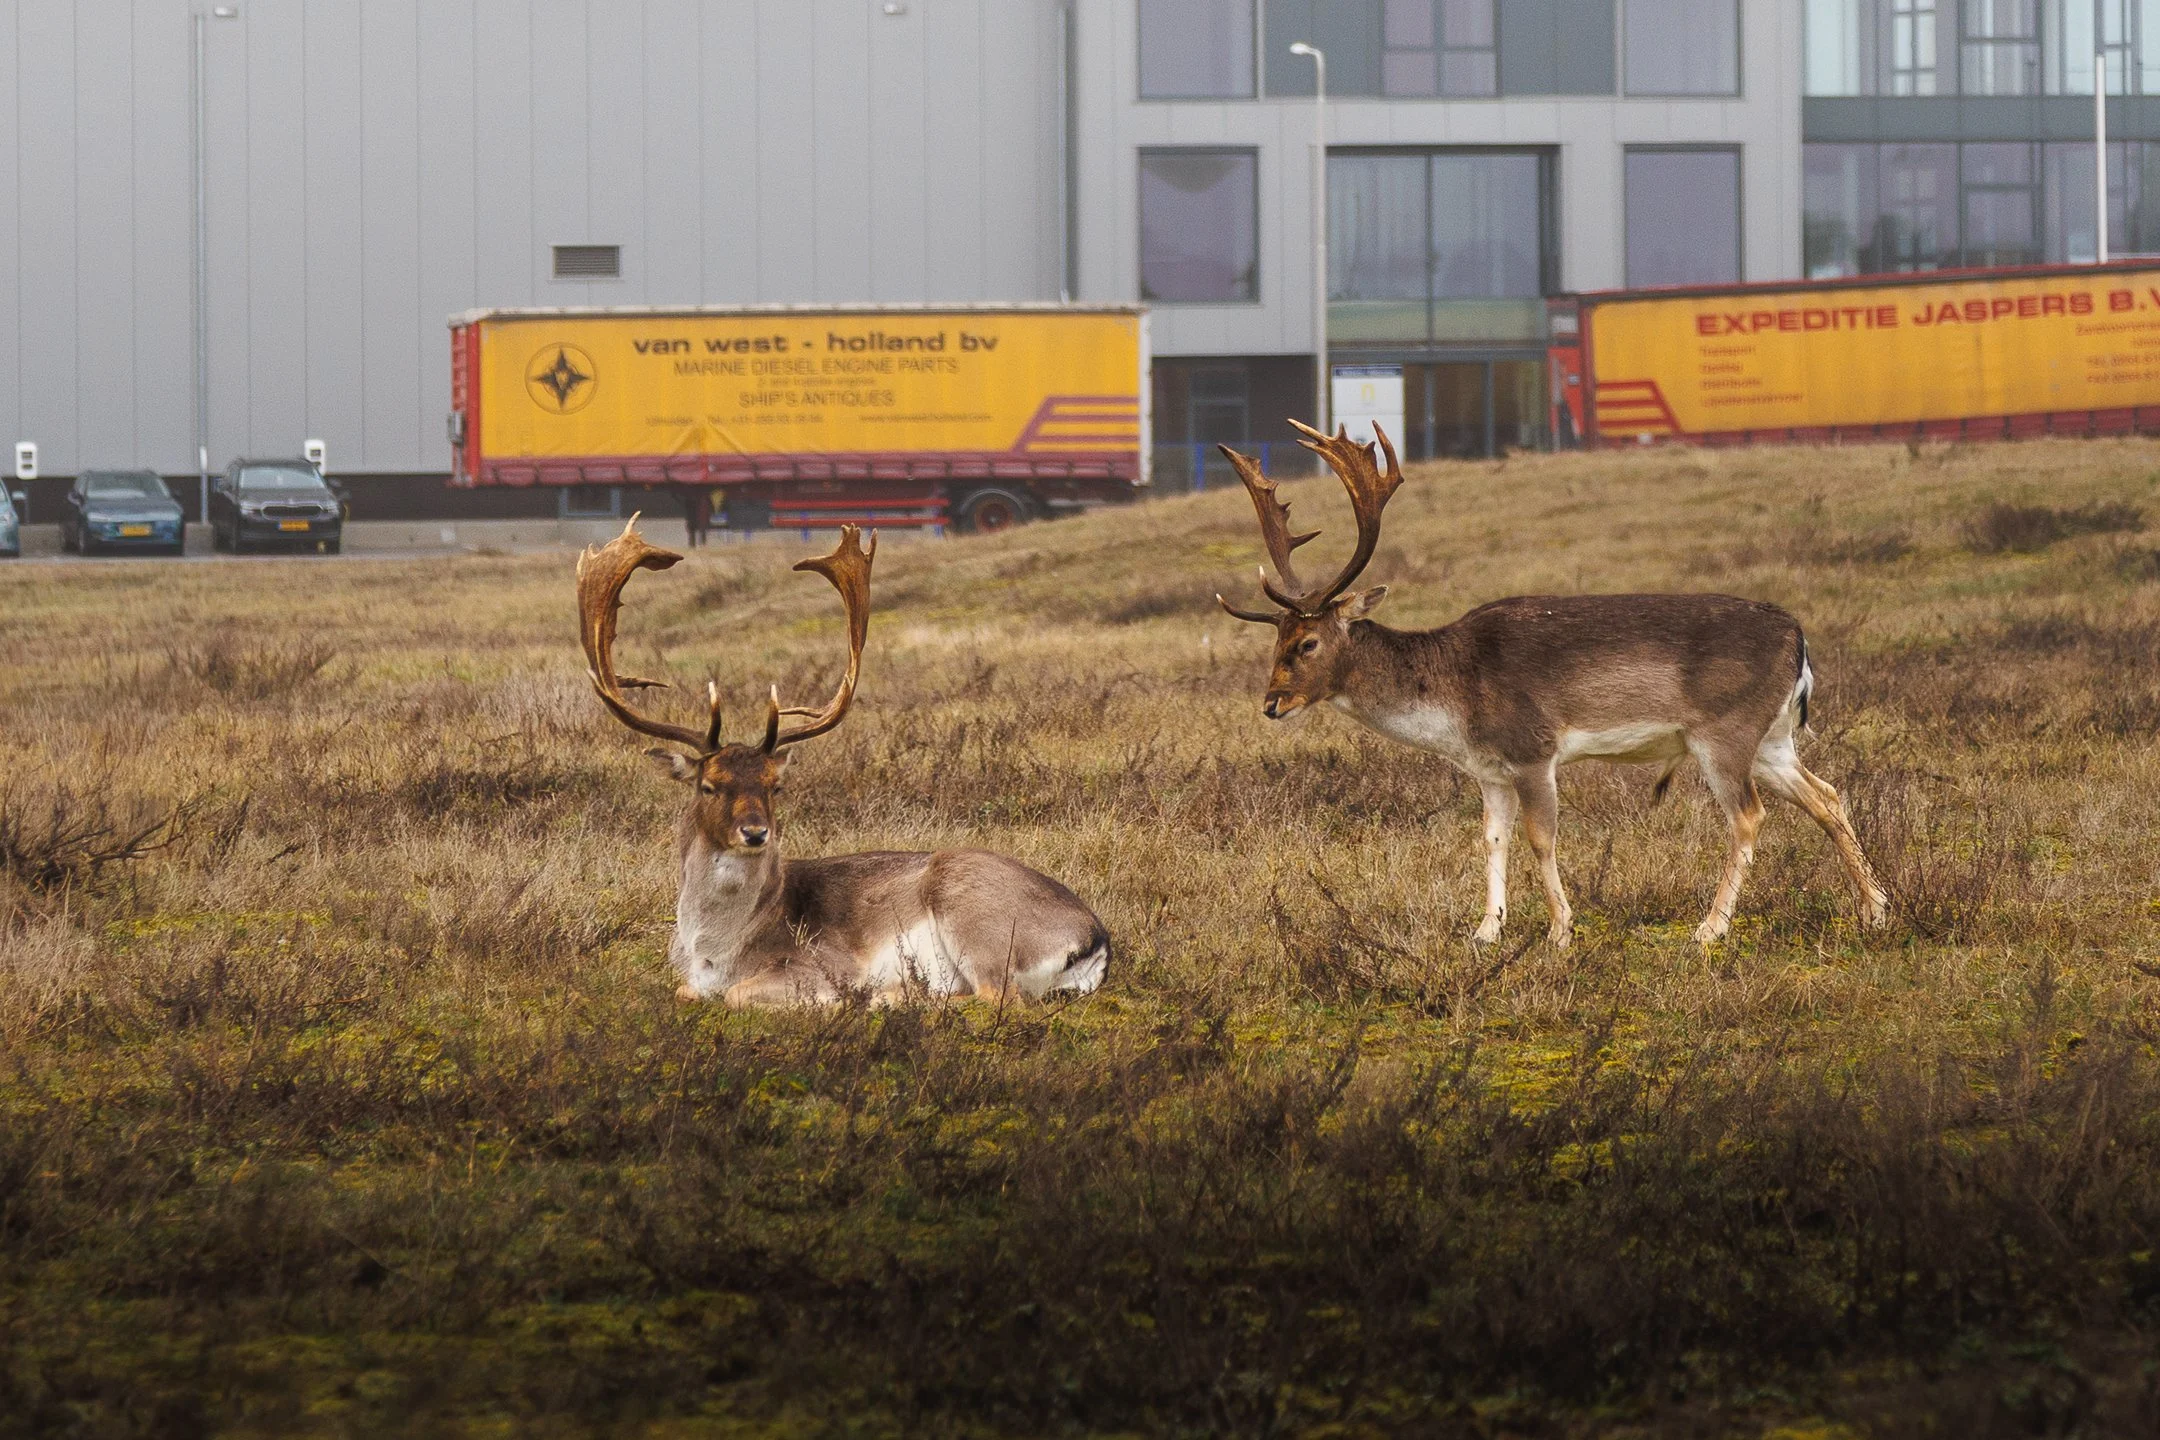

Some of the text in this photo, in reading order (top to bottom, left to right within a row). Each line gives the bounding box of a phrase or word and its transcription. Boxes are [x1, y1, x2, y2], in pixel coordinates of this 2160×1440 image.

[1697, 304, 1898, 336] EXPEDITIE
[1912, 291, 2093, 326] JASPERS
[633, 338, 691, 354] van
[704, 335, 789, 354] west
[827, 331, 946, 352] holland
[959, 331, 998, 352] bv
[674, 357, 959, 376] MARINE DIESEL ENGINE PARTS
[739, 389, 895, 408] SHIP'S ANTIQUES
